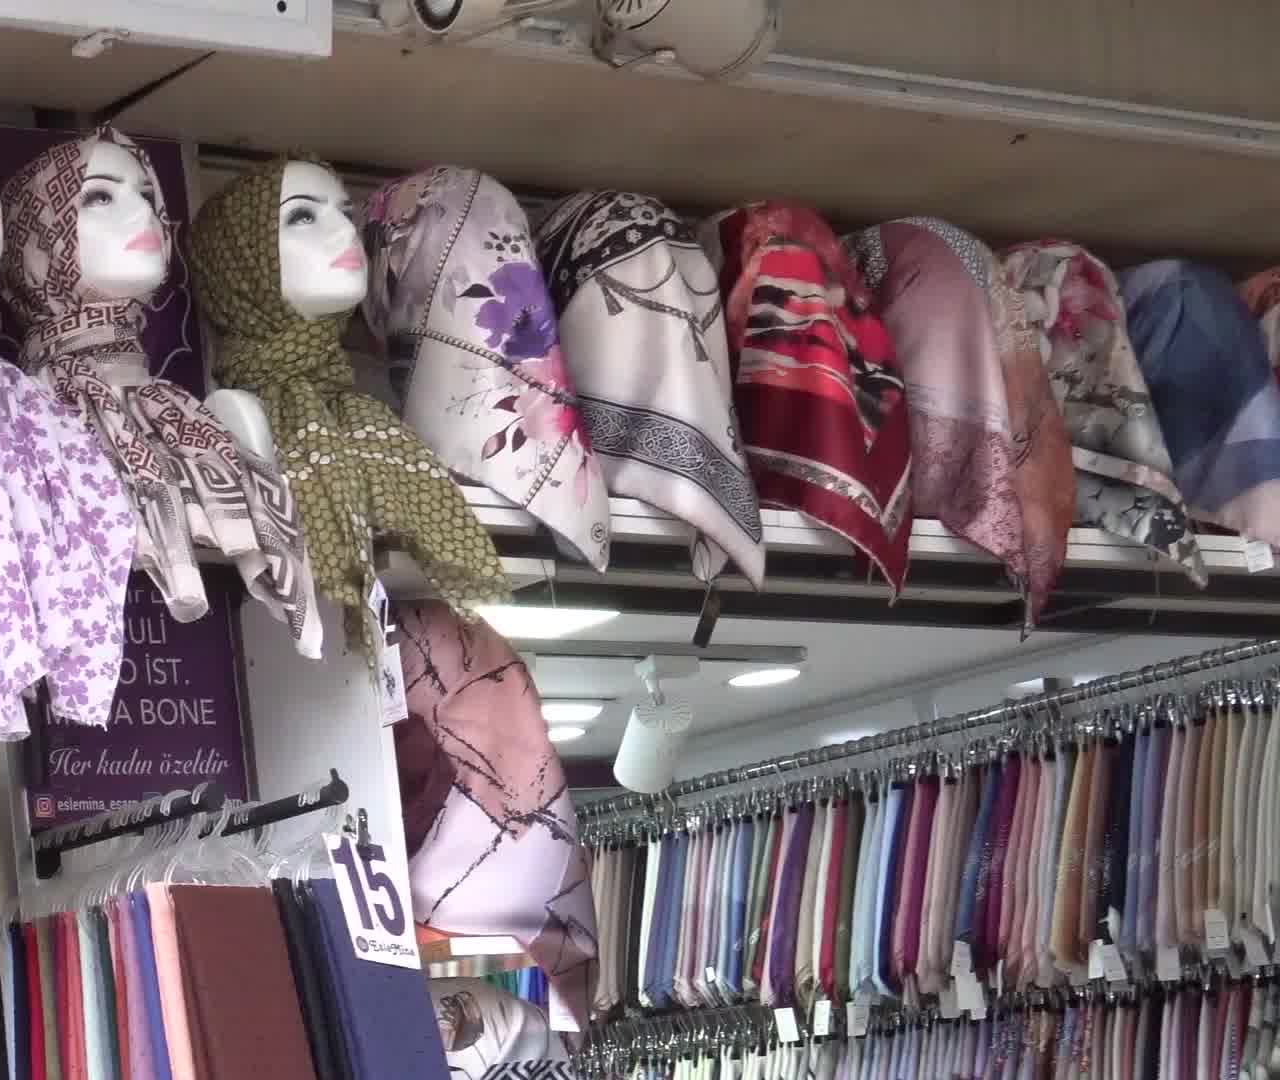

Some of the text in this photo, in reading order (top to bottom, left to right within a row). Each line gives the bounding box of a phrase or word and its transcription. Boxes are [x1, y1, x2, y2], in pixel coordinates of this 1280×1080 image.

[140, 699, 217, 726] BONE
[49, 747, 92, 776] Her
[159, 747, 231, 776] özeldir
[331, 836, 406, 937] 15
